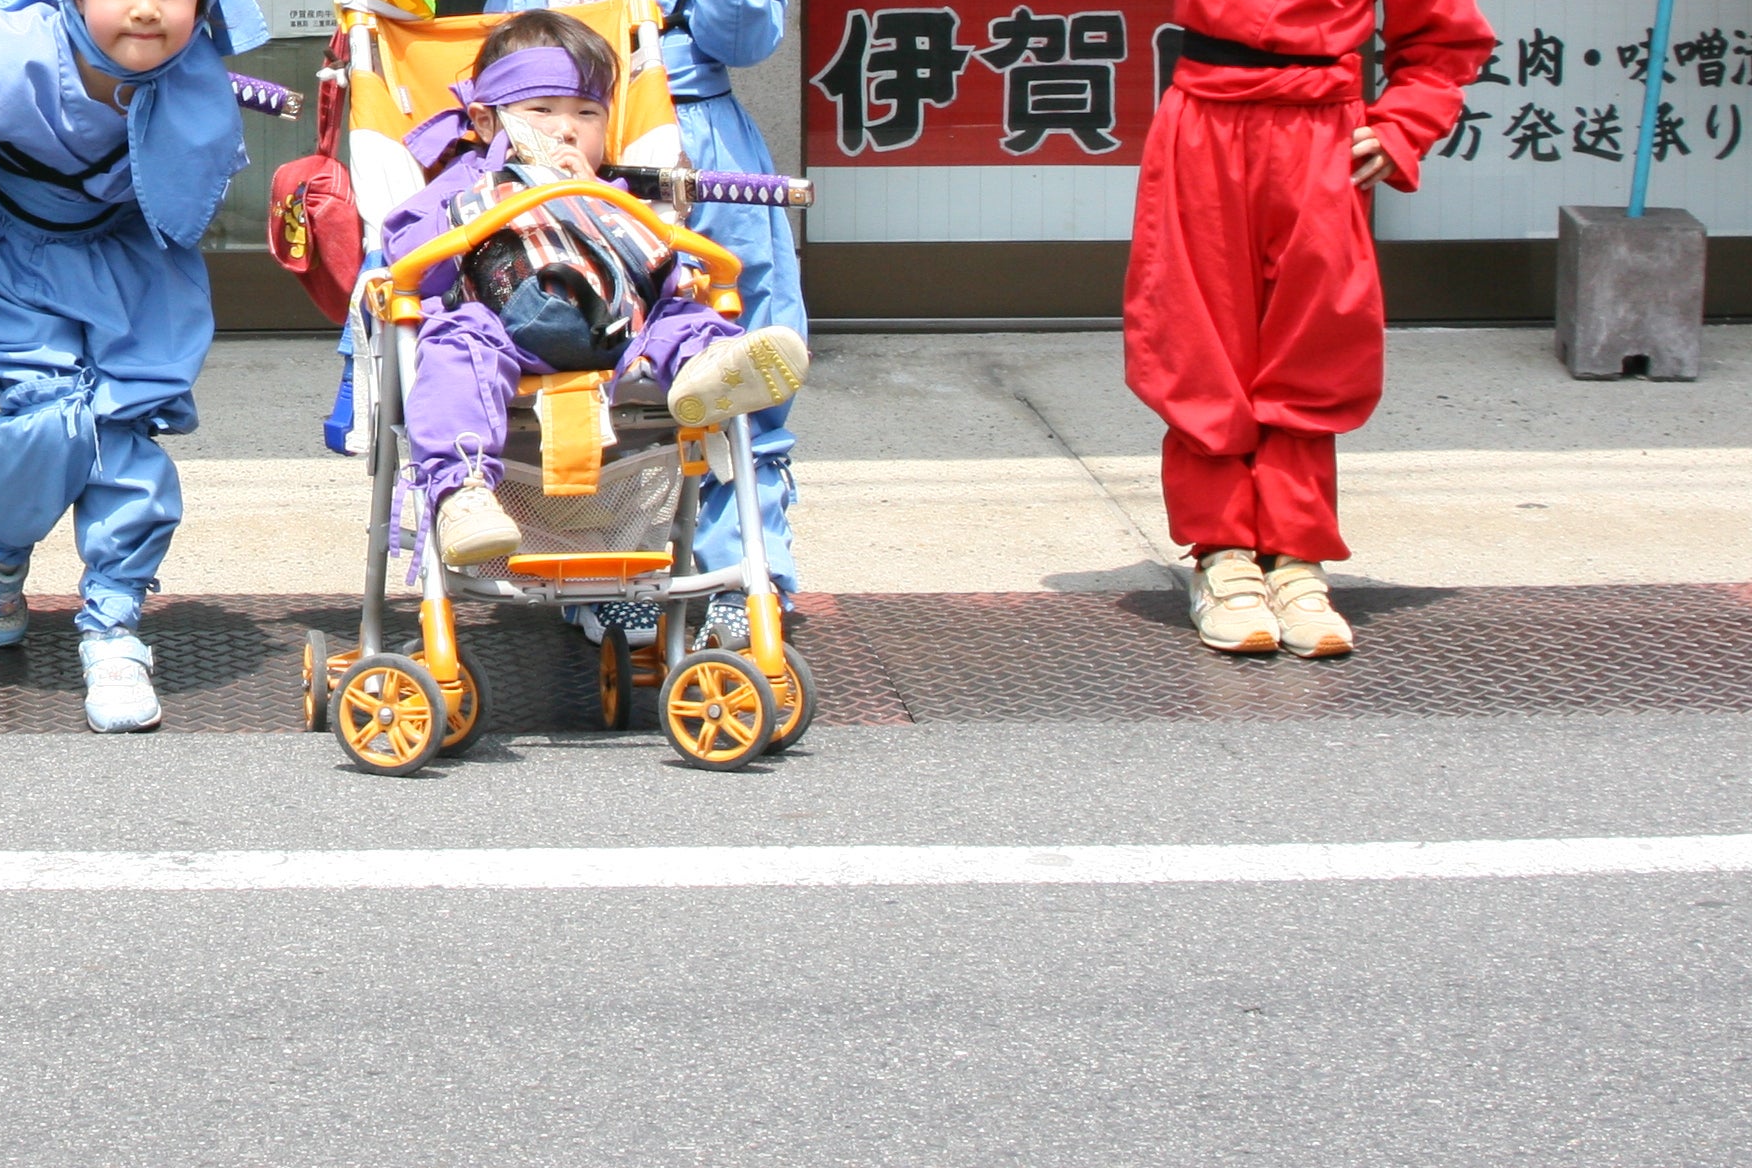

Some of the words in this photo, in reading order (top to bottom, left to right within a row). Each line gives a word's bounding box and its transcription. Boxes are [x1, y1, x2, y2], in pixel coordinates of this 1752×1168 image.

[290, 10, 336, 19] 伊賀産肉牛
[809, 4, 1184, 157] 伊賀
[1436, 100, 1742, 162] 方発送承り
